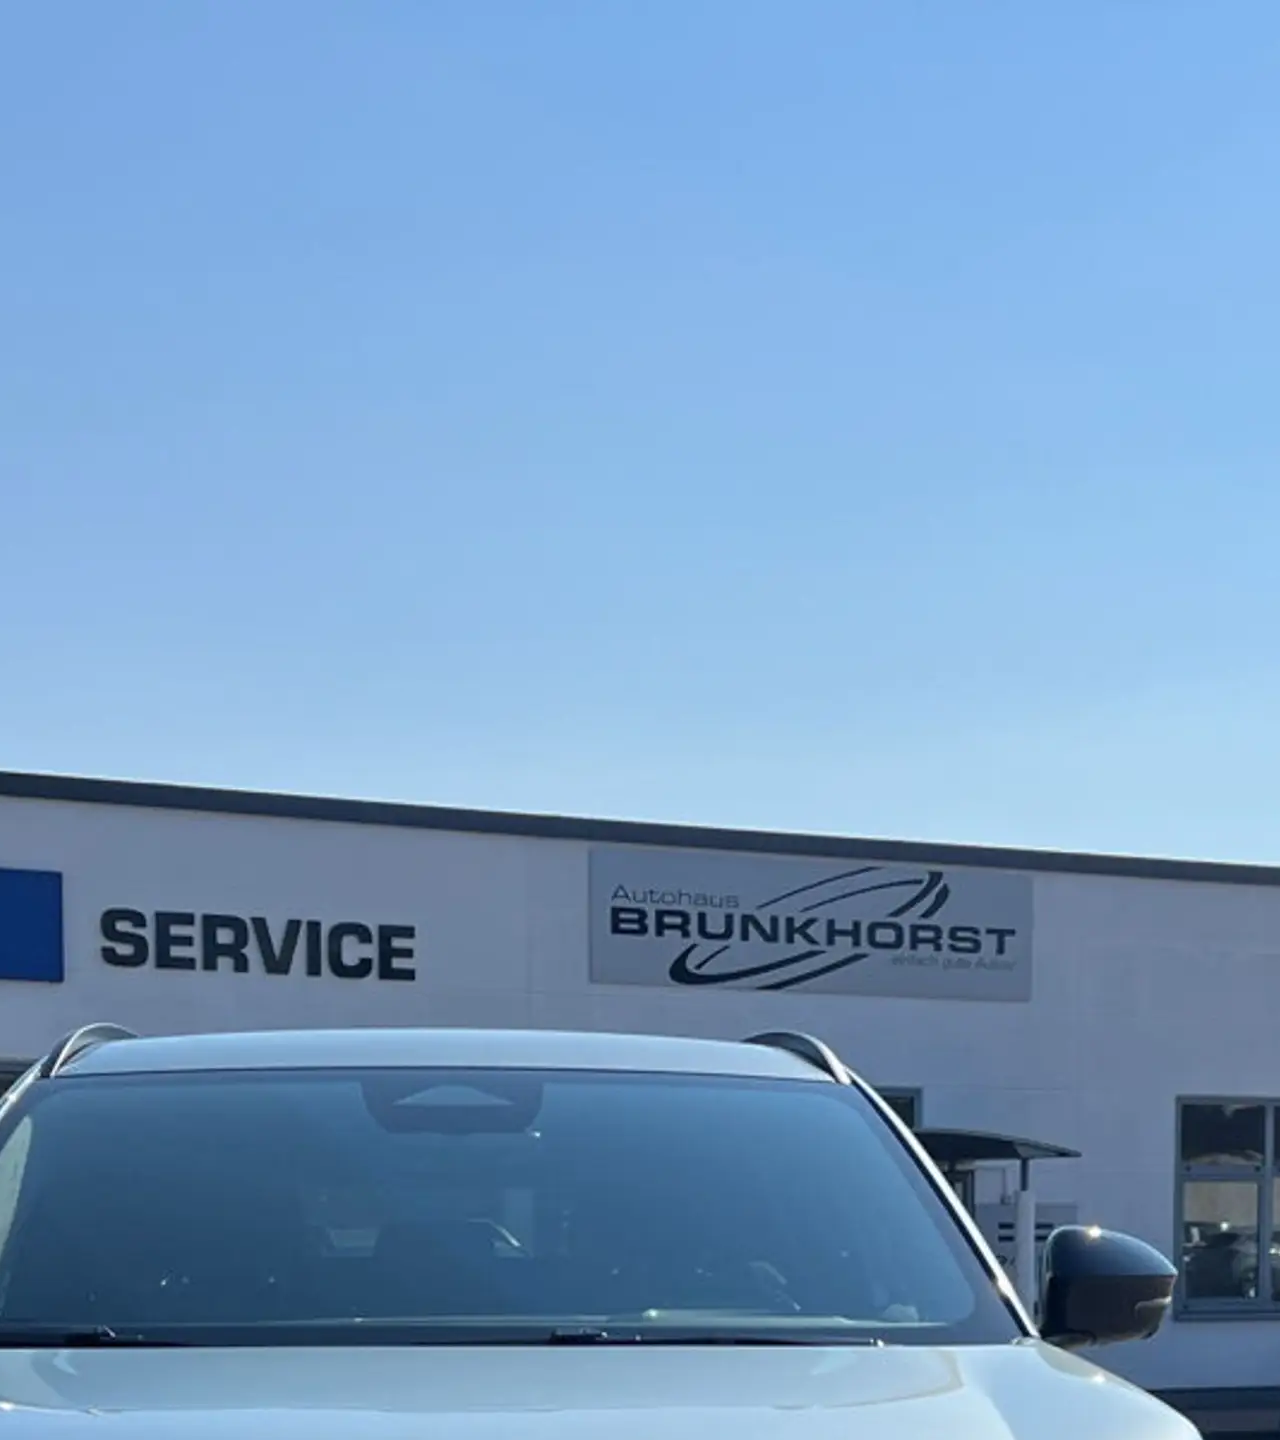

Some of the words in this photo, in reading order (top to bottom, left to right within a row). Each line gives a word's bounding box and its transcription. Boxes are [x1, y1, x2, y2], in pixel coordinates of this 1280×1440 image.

[610, 883, 741, 910] Autohaus
[99, 908, 416, 982] SERVICE
[610, 904, 1018, 957] BRUNKHORST
